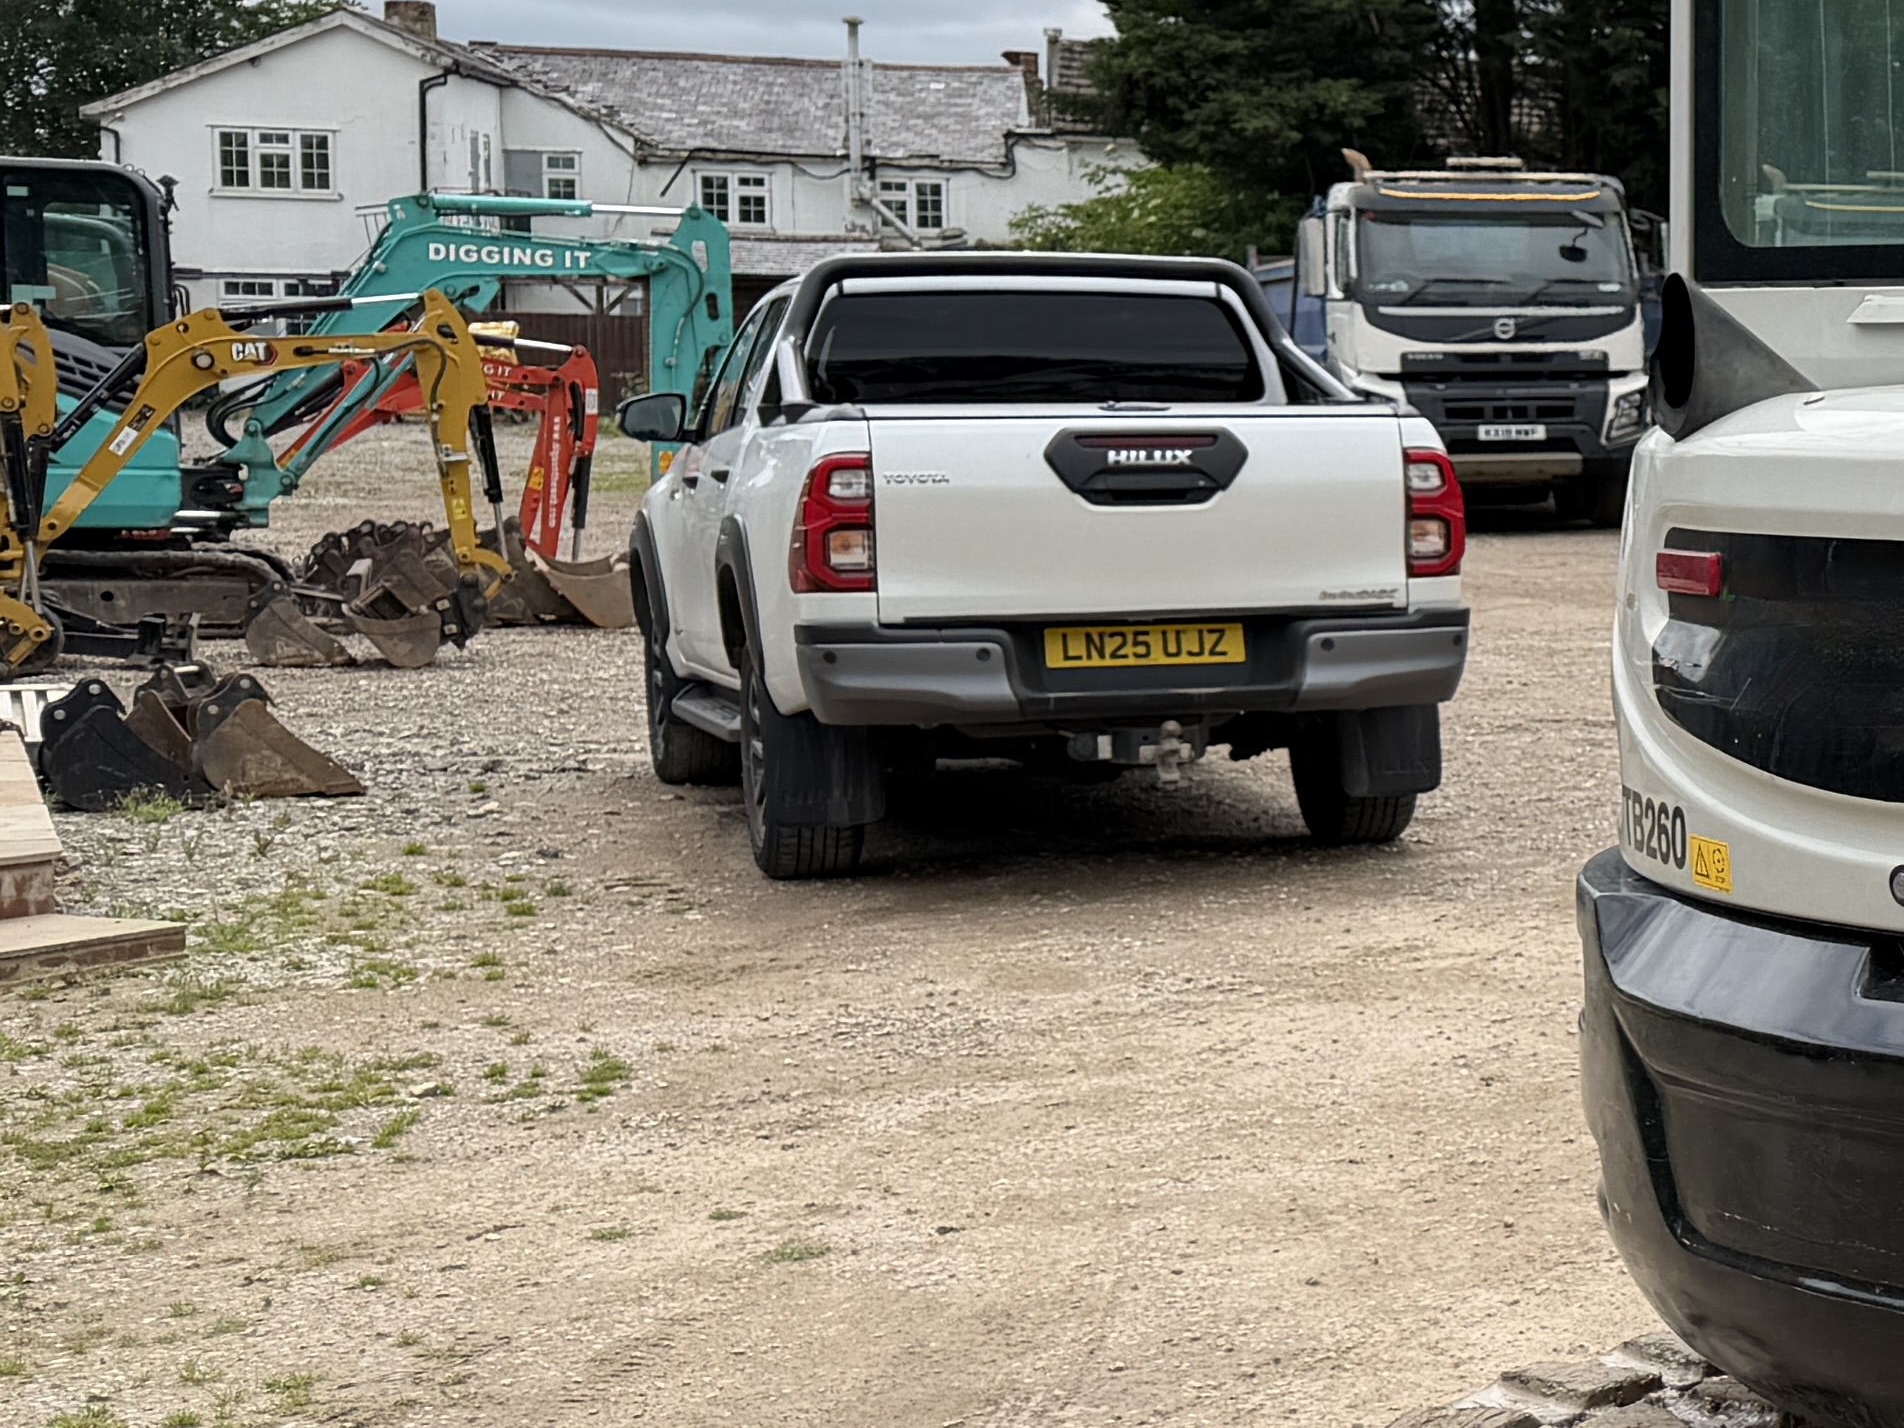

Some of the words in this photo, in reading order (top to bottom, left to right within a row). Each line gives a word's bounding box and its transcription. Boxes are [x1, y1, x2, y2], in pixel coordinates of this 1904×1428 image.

[428, 243, 554, 268] DIGGING
[564, 251, 592, 269] IT
[231, 343, 267, 361] CAT
[497, 365, 511, 376] IT
[1107, 449, 1193, 465] HILUX
[884, 473, 950, 484] TOYOTA
[1061, 631, 1151, 662] LN25
[1161, 628, 1229, 658] UJZ
[1621, 784, 1687, 870] TB260
